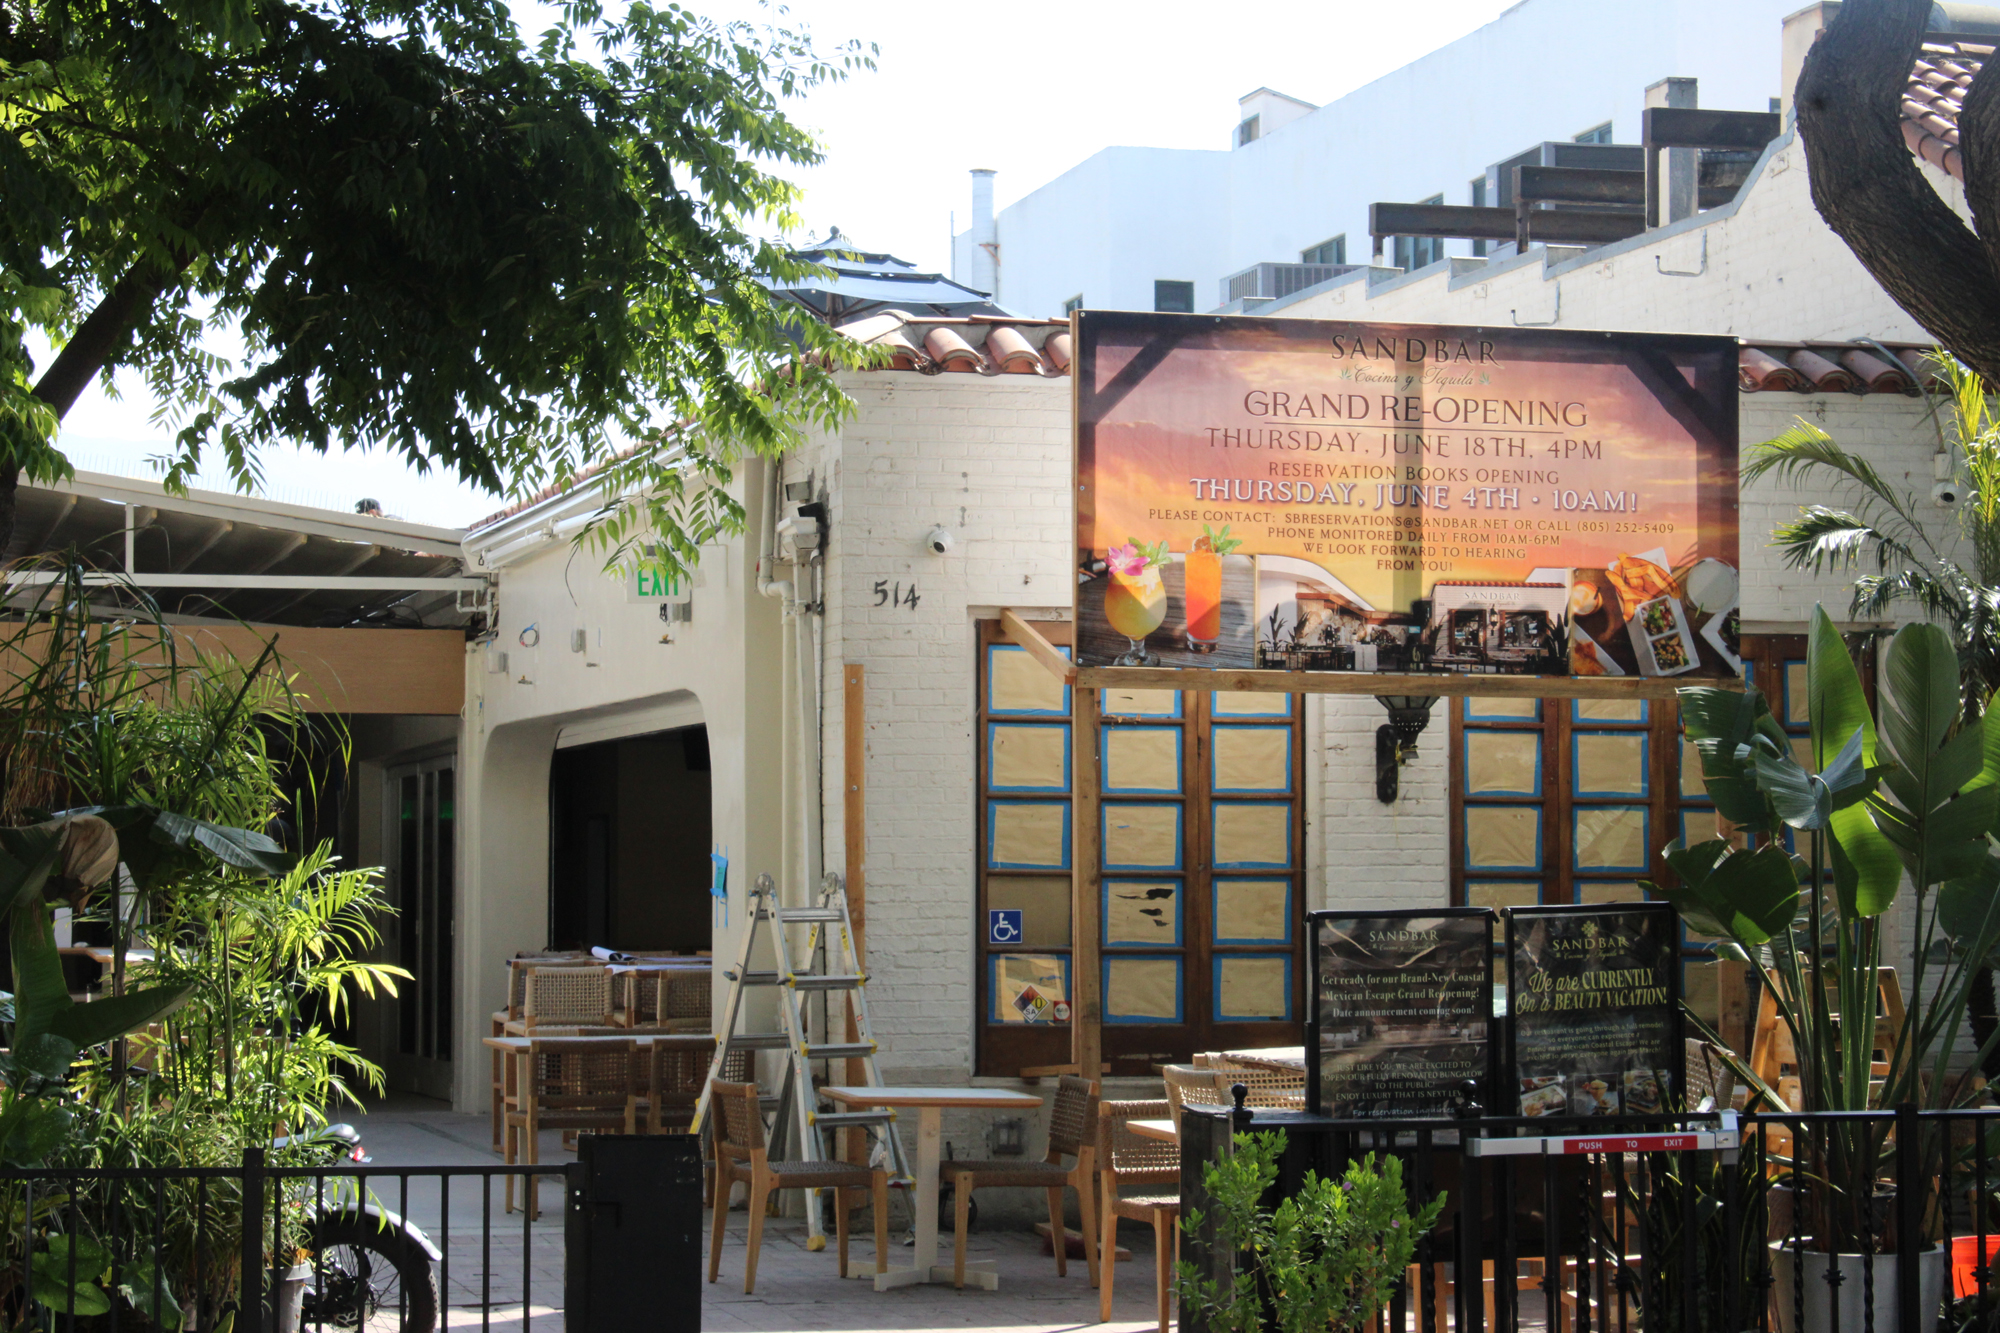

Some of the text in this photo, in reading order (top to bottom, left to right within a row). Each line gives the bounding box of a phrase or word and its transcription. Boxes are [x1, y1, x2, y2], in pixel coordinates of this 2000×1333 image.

[1331, 334, 1502, 367] SANDBAR
[1354, 364, 1475, 394] Cocina y Tequila
[1243, 390, 1589, 428] GRAND RE-OPENING
[1203, 427, 1603, 460] THURSDAY, JUNE 18TH, 4PM
[1268, 461, 1560, 485] RESERVATION BOOKS OPENING
[1189, 478, 1638, 513] THURSDAY, JUNE 4TH 10AM!
[1148, 508, 1675, 535] PLEASE CONTACT: SBRESERVATIONS@SANDBAR.NET OR CALL (805) 252-5409
[1267, 526, 1561, 546] PHONE MONITORED DAILY FROM 10AM-6PM
[1303, 542, 1527, 560] WE LOOK FORWARD TO HEARING
[1376, 559, 1454, 572] FROM YOU!
[873, 579, 921, 611] 514
[1463, 591, 1522, 601] SANDBAR
[1369, 930, 1440, 942] SANDBAR
[1552, 936, 1630, 951] SANDBAR
[1321, 971, 1485, 988] Get ready for our Brand-New Coastal
[1528, 967, 1655, 993] We are CURRENTLY
[1325, 987, 1480, 1003] Mexican Escape Grand Reopening!
[1514, 986, 1668, 1015] On a BEAUTY VACATION!
[1035, 997, 1043, 1010] 0
[1332, 1004, 1475, 1018] Date announcement coming soon!
[1575, 1026, 1593, 1035] going
[1594, 1024, 1620, 1034] through
[1557, 1035, 1587, 1043] everyone
[1600, 1032, 1635, 1041] experience
[1590, 1041, 1614, 1049] Coastal
[1356, 1062, 1374, 1071] LIKE
[1395, 1062, 1408, 1070] WE
[1408, 1061, 1424, 1070] ARE
[1426, 1060, 1459, 1069] EXCITED
[1460, 1060, 1472, 1068] TO
[1324, 1069, 1484, 1082] OPEN OUR FULLY RENOVATED BUNGALOW
[1375, 1082, 1387, 1090] TO
[1388, 1081, 1404, 1089] THE
[1335, 1088, 1463, 1101] ENJOY LUXURY THAT IS NEXT LEV
[1352, 1104, 1456, 1117] For reservation inquiries
[1578, 1138, 1684, 1150] PUSH TO EXIT
